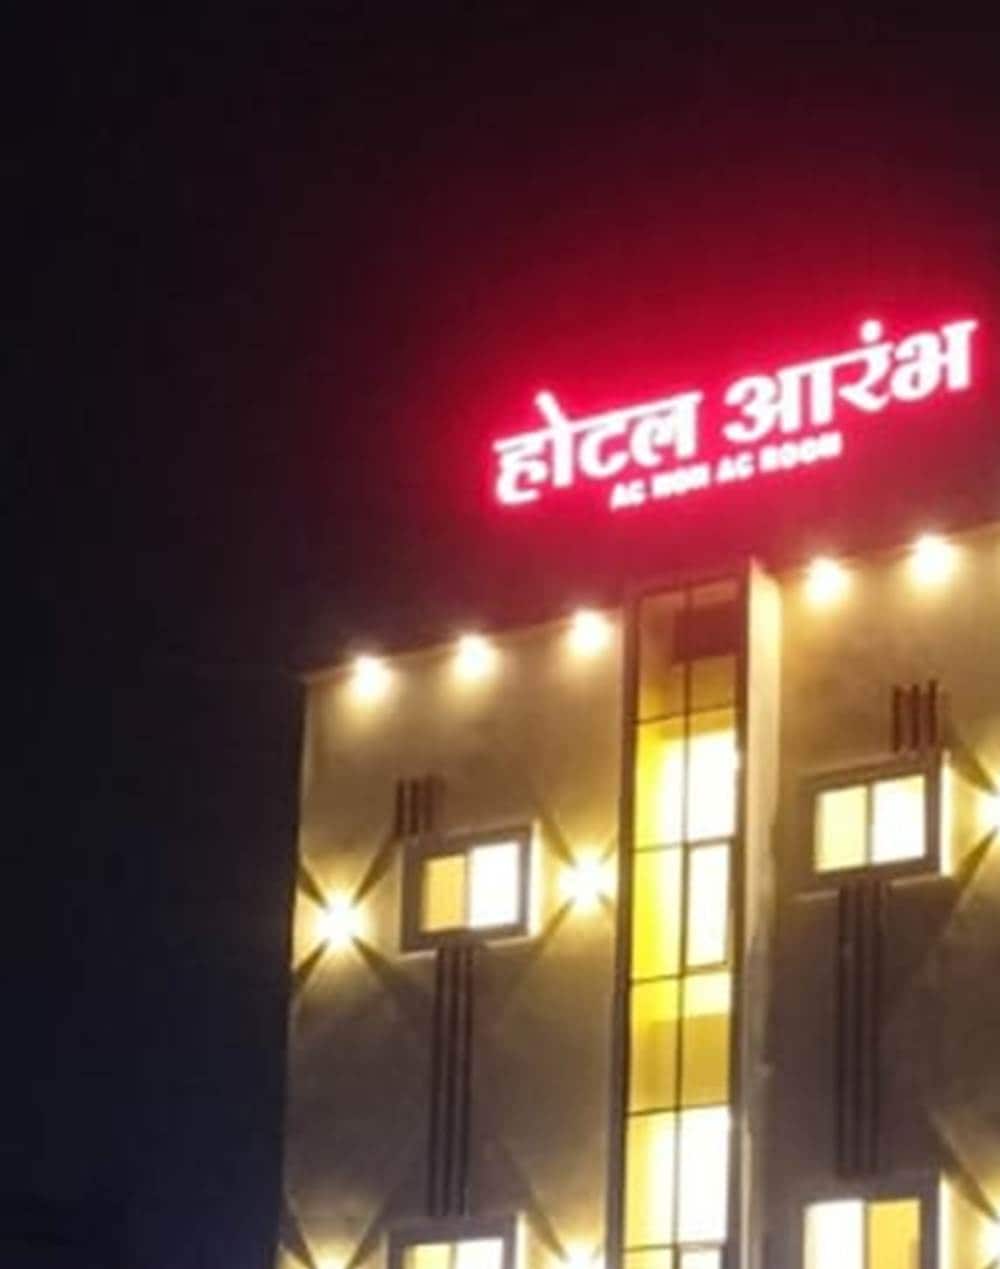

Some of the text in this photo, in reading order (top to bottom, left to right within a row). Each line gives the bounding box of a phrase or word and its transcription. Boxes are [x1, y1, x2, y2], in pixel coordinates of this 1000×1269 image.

[493, 319, 978, 504] होटल आरंभ
[609, 481, 644, 509] AC
[716, 454, 754, 483] AC
